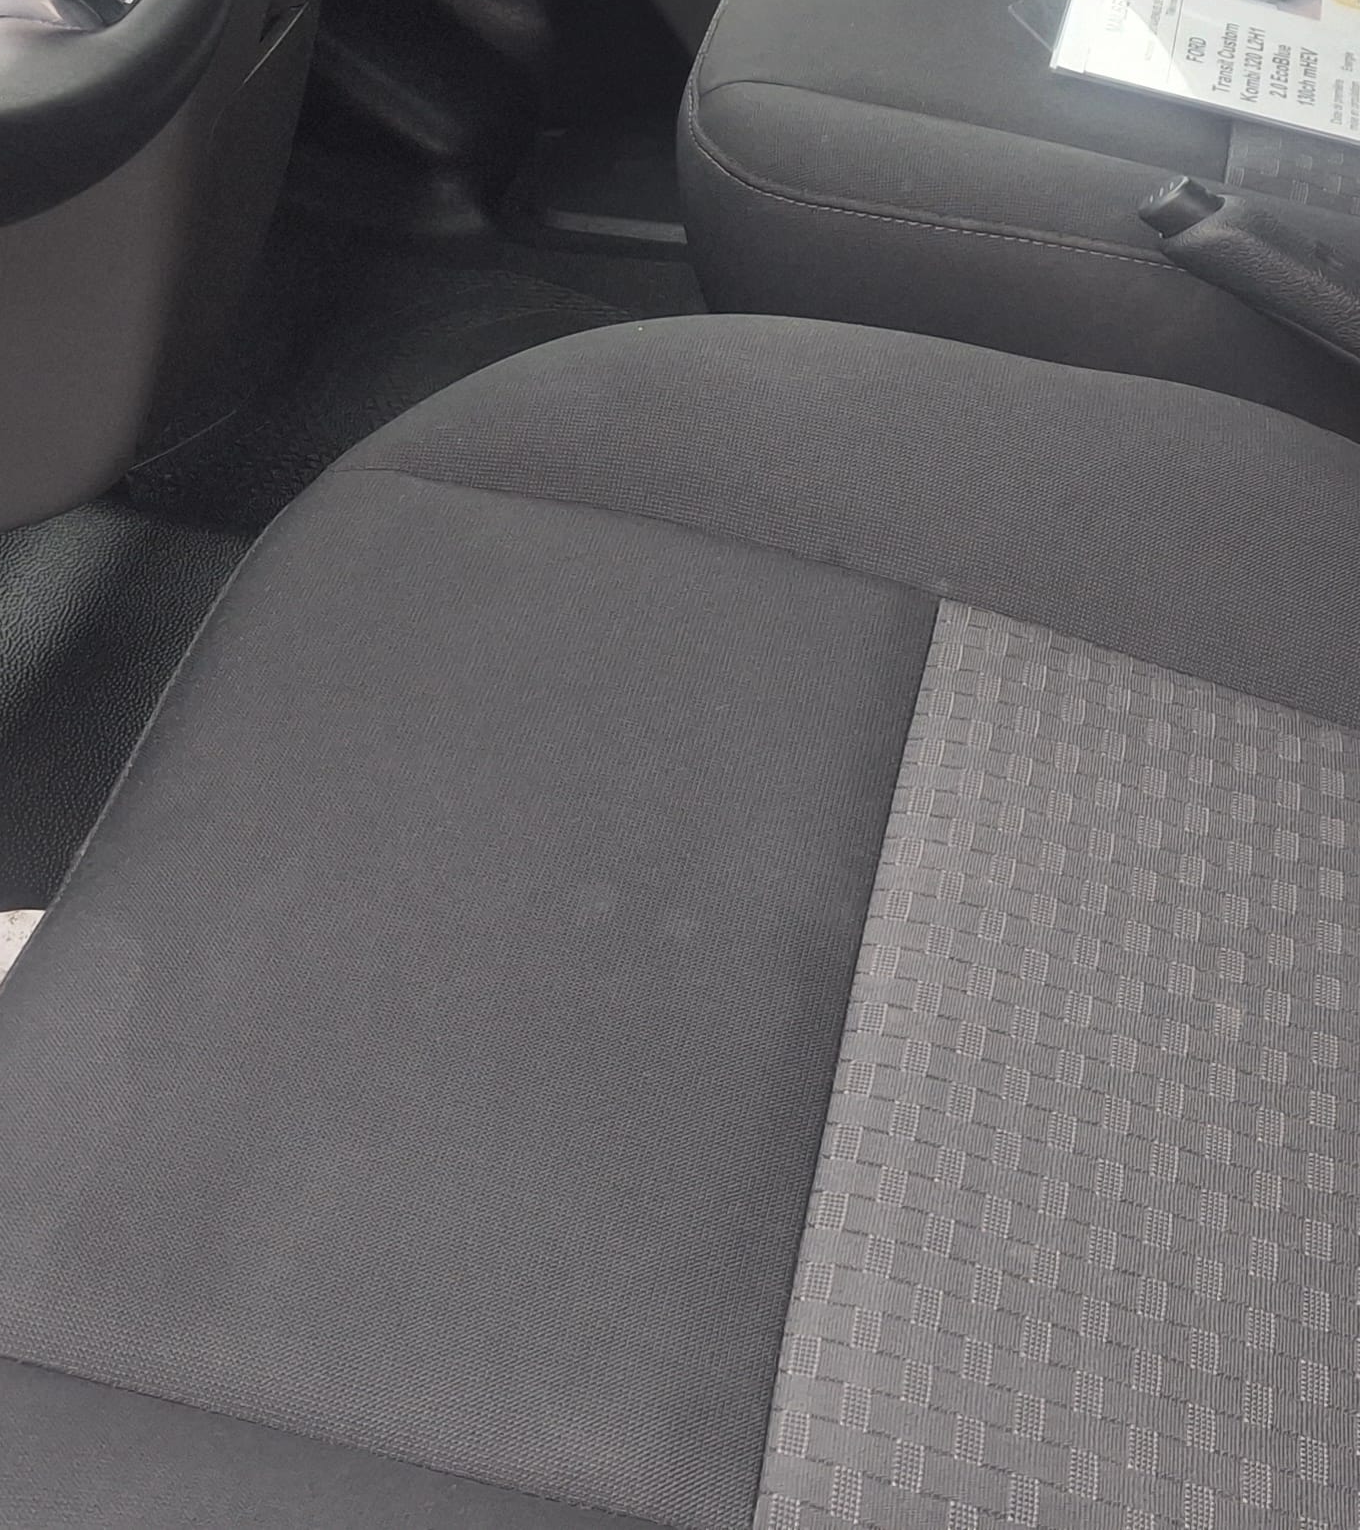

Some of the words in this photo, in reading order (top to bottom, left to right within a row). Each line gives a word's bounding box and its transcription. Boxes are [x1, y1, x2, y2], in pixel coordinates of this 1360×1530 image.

[1187, 35, 1207, 64] FORD
[1217, 21, 1240, 60] Custom
[1248, 25, 1265, 52] L2H1
[1212, 57, 1235, 95] Transit
[1270, 42, 1291, 83] EcoBlue
[1301, 46, 1318, 79] mHEV
[1239, 68, 1261, 103] Kombi
[1297, 77, 1315, 107] 130ch
